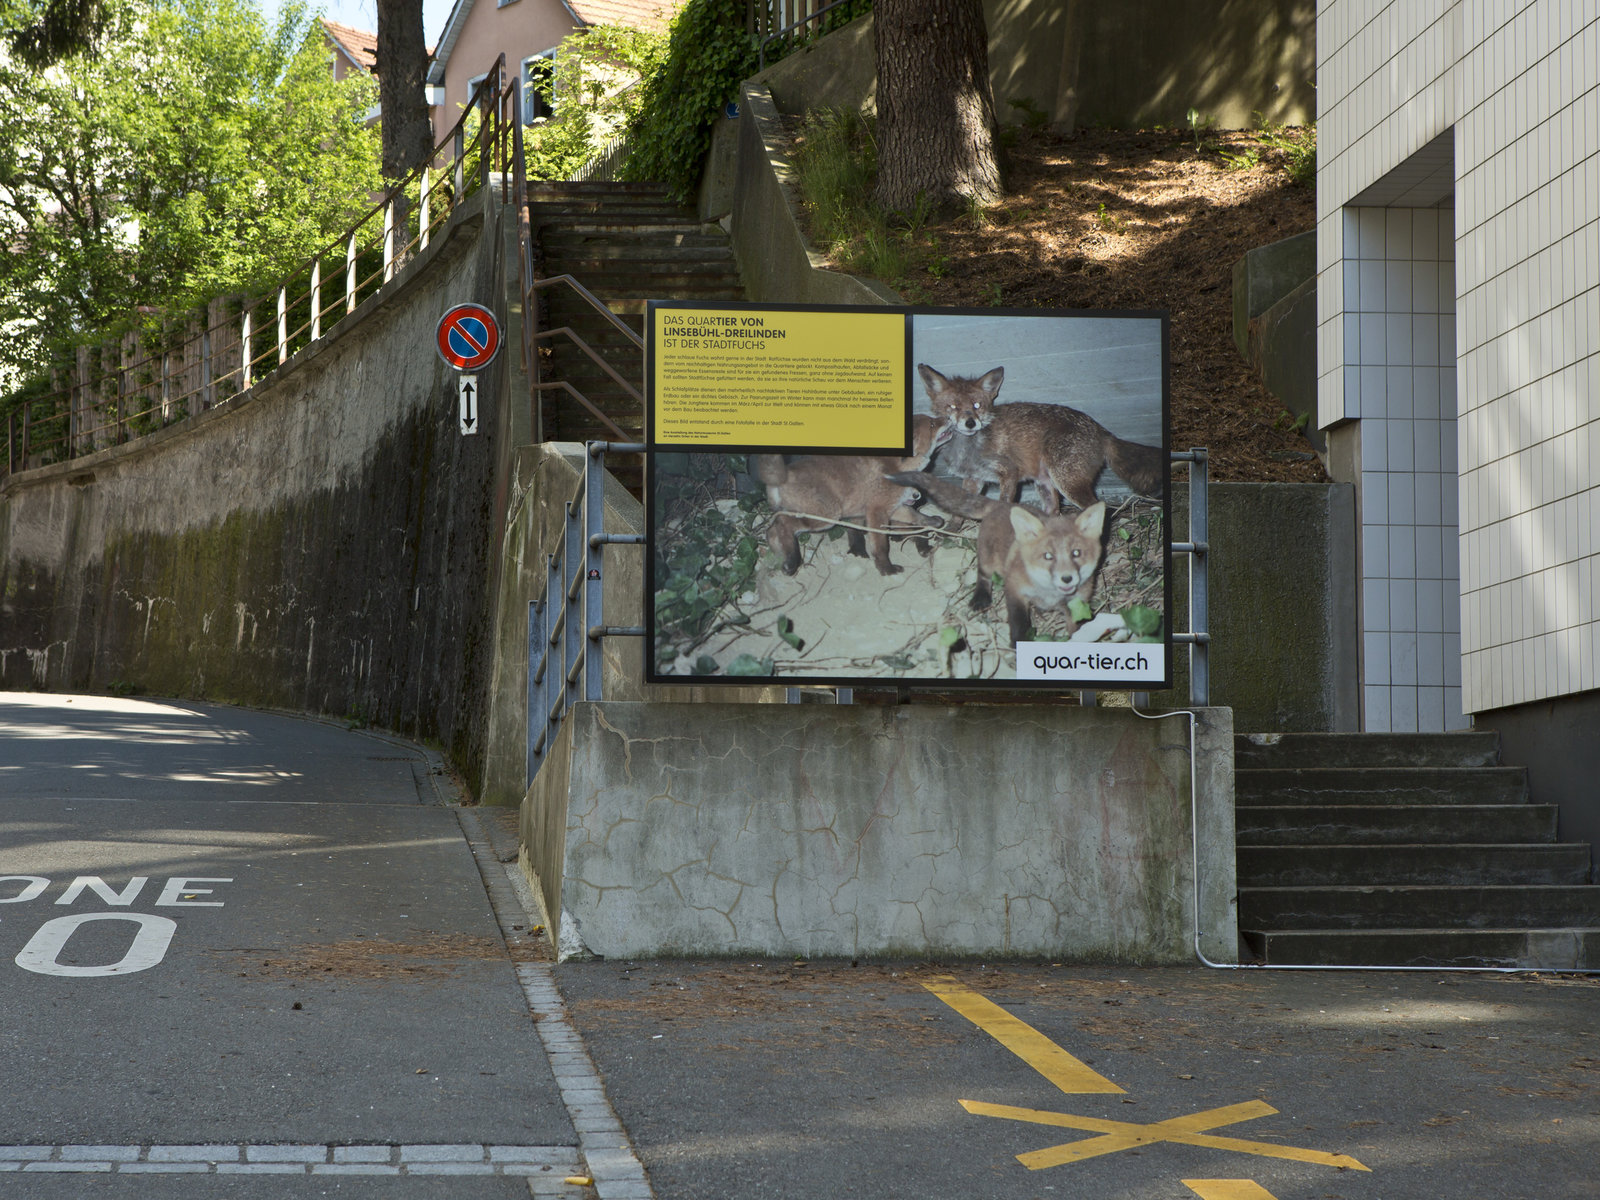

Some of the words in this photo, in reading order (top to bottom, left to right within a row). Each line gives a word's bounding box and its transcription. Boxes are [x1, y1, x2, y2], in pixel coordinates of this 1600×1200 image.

[664, 316, 684, 325] DAS
[688, 316, 737, 326] QUARTIER
[741, 318, 764, 326] VON
[664, 326, 786, 338] LINSEBÜHL-DREILINDEN
[664, 338, 678, 348] IST
[681, 339, 700, 348] DER
[703, 340, 766, 350] STADTFUCHS
[1034, 652, 1148, 674] quar-tier.ch
